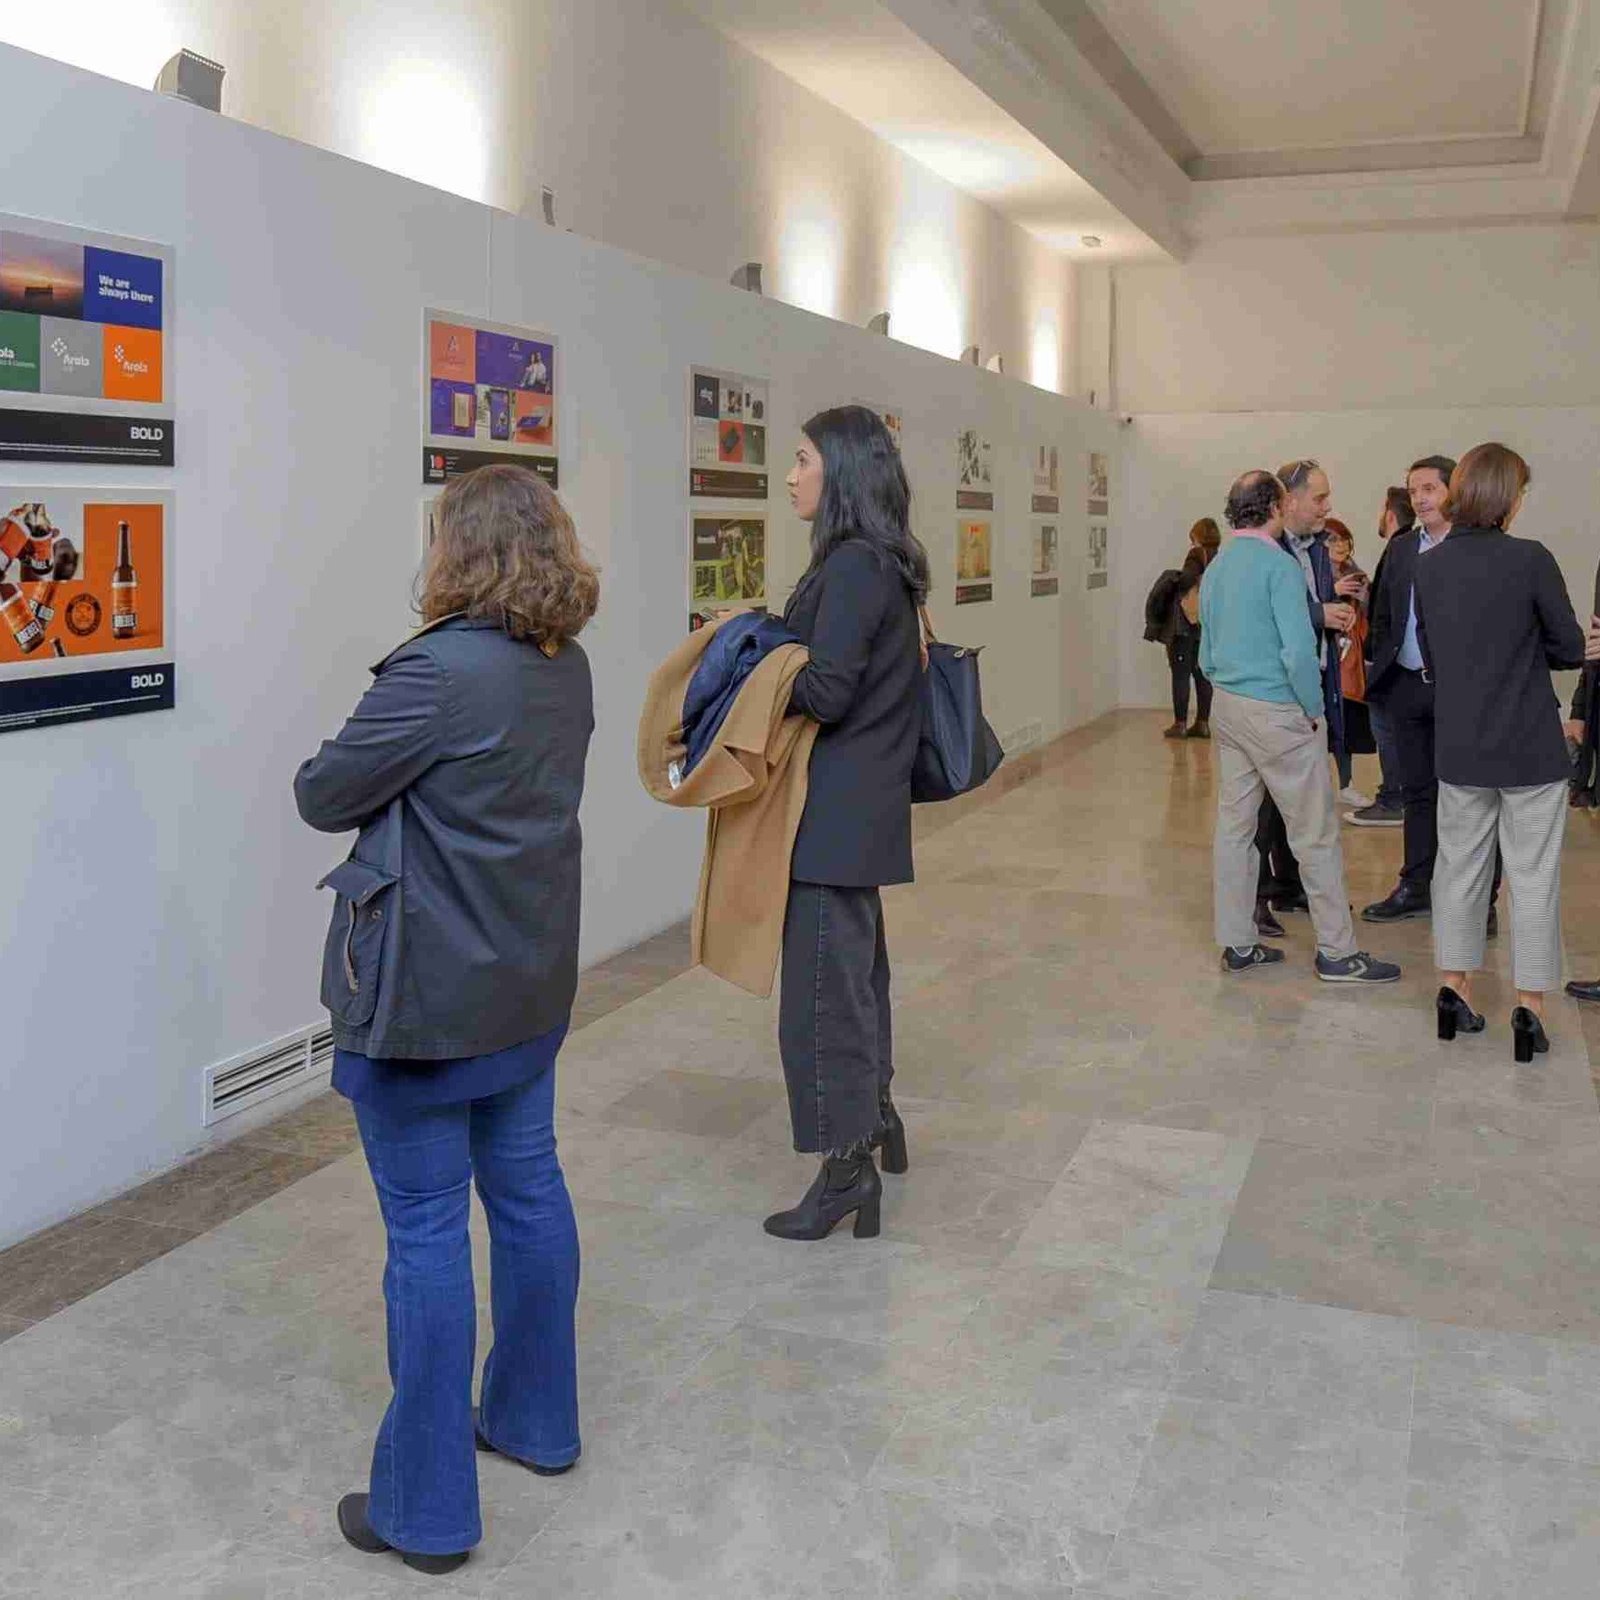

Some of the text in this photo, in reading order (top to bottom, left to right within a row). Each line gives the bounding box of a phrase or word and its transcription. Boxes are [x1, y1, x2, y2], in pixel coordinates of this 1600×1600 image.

[98, 274, 130, 289] We are
[98, 286, 154, 304] always there
[130, 426, 164, 440] BOLD
[131, 672, 164, 689] BOLD
